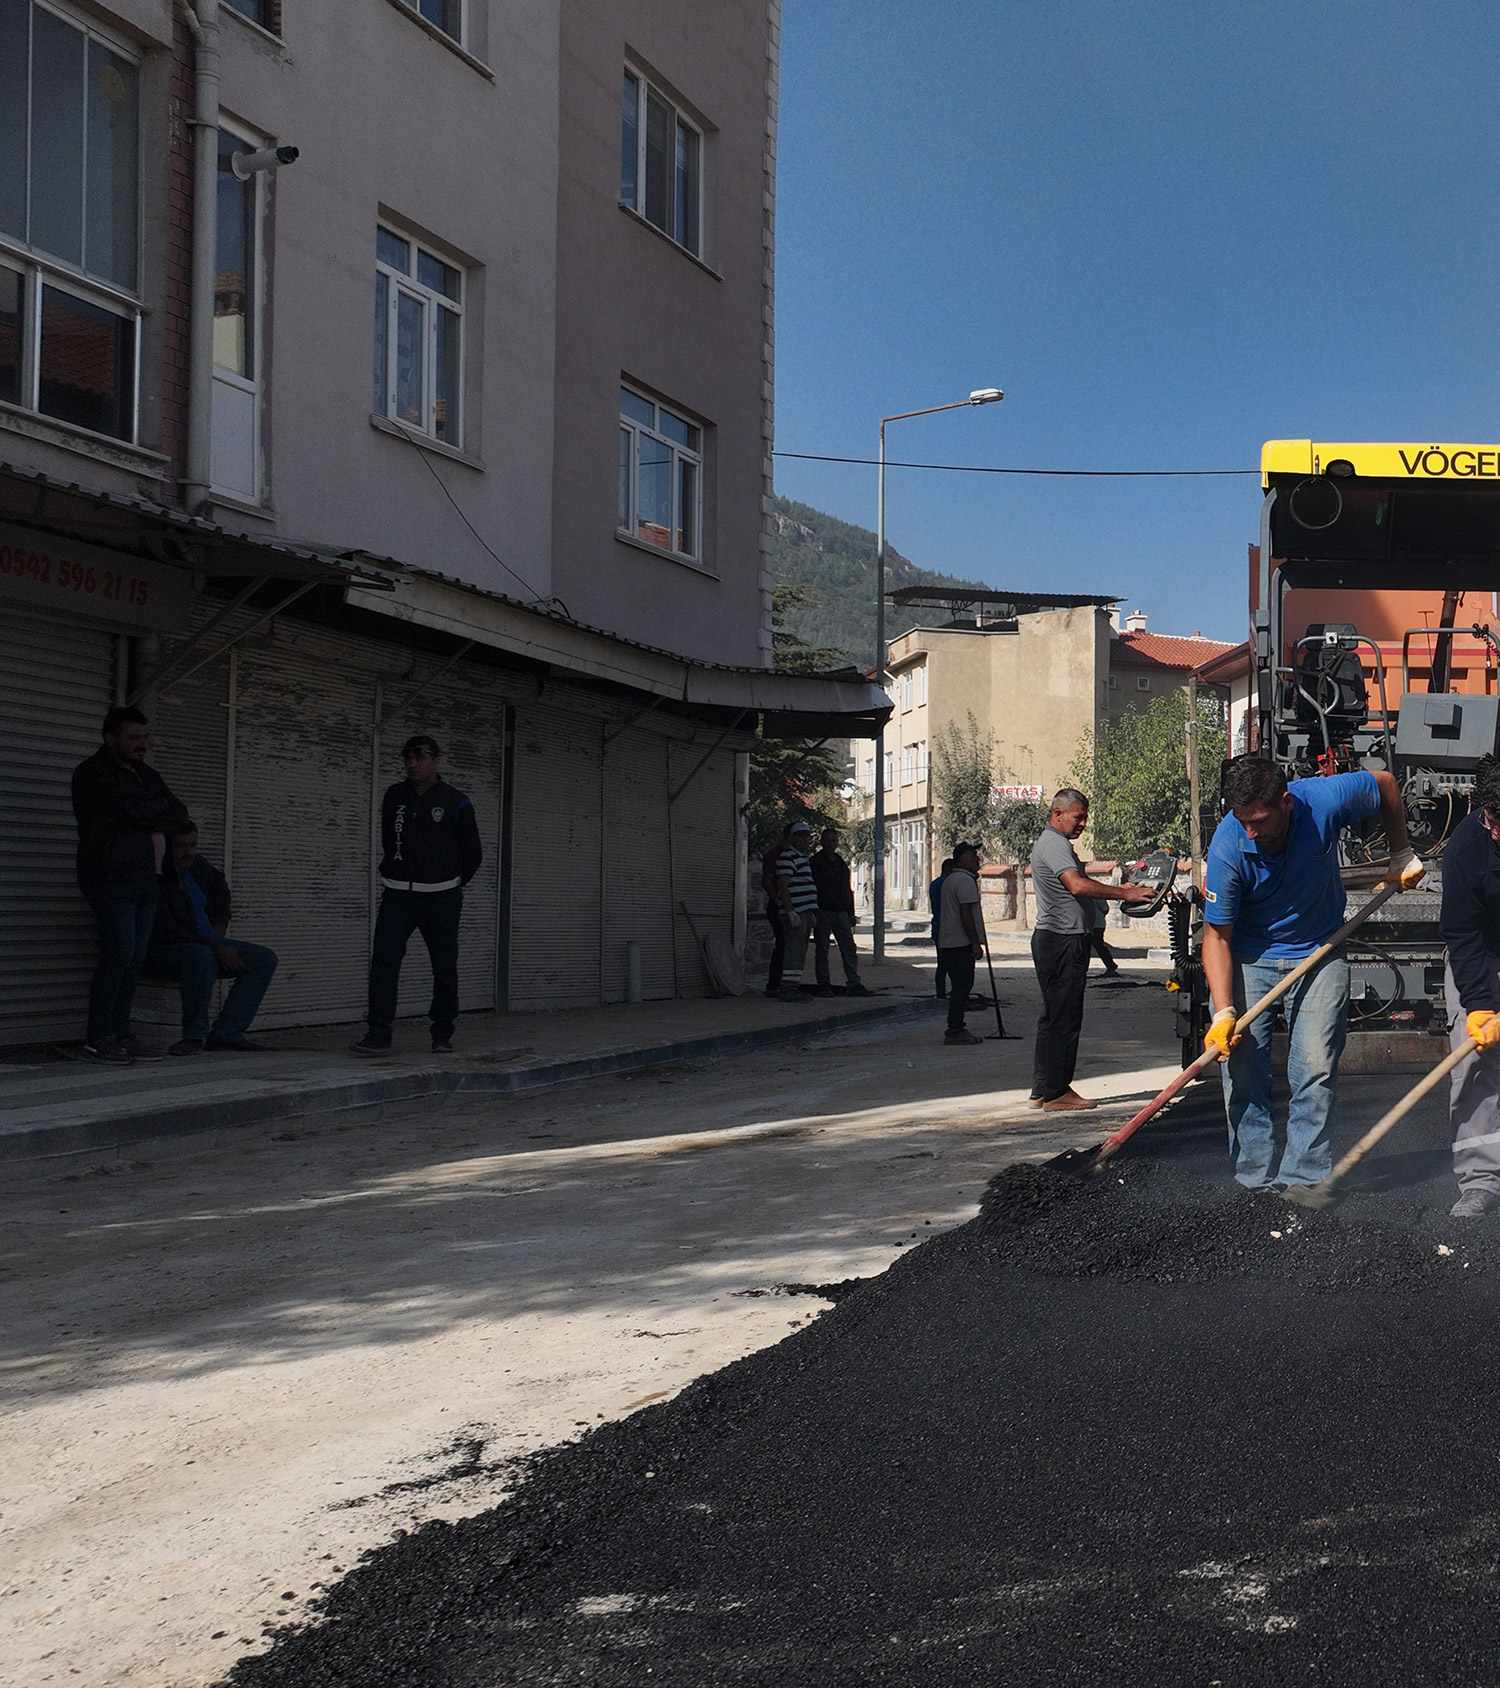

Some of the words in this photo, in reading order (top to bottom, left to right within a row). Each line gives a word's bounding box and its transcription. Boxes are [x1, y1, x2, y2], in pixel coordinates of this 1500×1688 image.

[0, 545, 51, 584] 0542
[58, 560, 97, 594] 596
[103, 571, 122, 601] 21
[129, 578, 148, 606] 15
[393, 804, 407, 861] ZABITA
